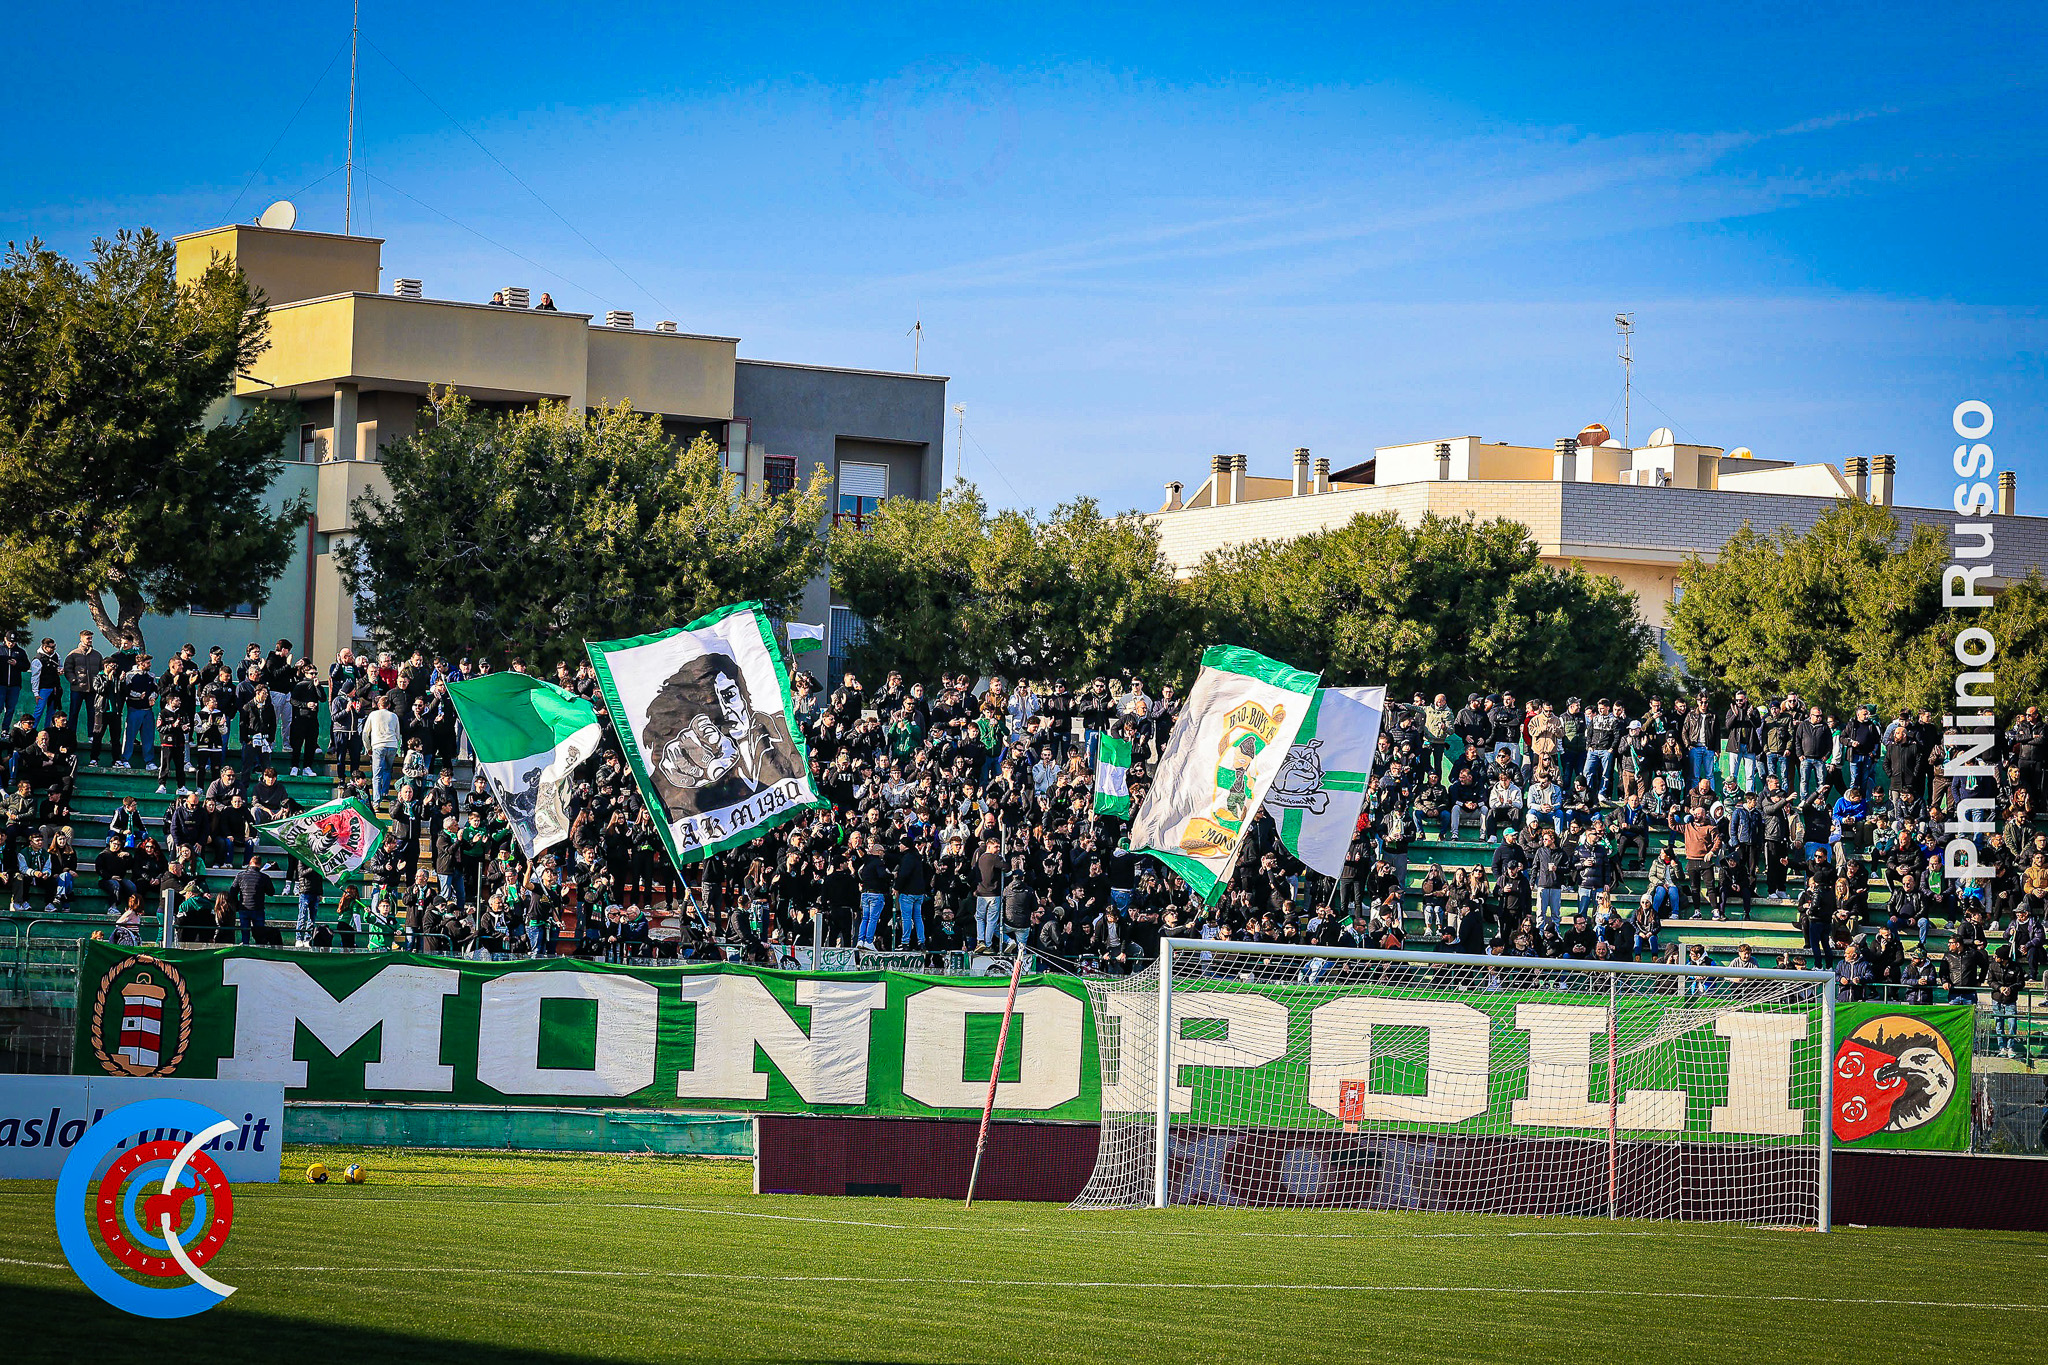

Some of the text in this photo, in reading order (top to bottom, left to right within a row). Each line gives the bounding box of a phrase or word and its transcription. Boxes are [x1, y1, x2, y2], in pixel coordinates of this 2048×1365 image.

[756, 780, 803, 819] 1980
[1201, 827, 1236, 851] MONO
[218, 957, 1812, 1137] MONOPOLI
